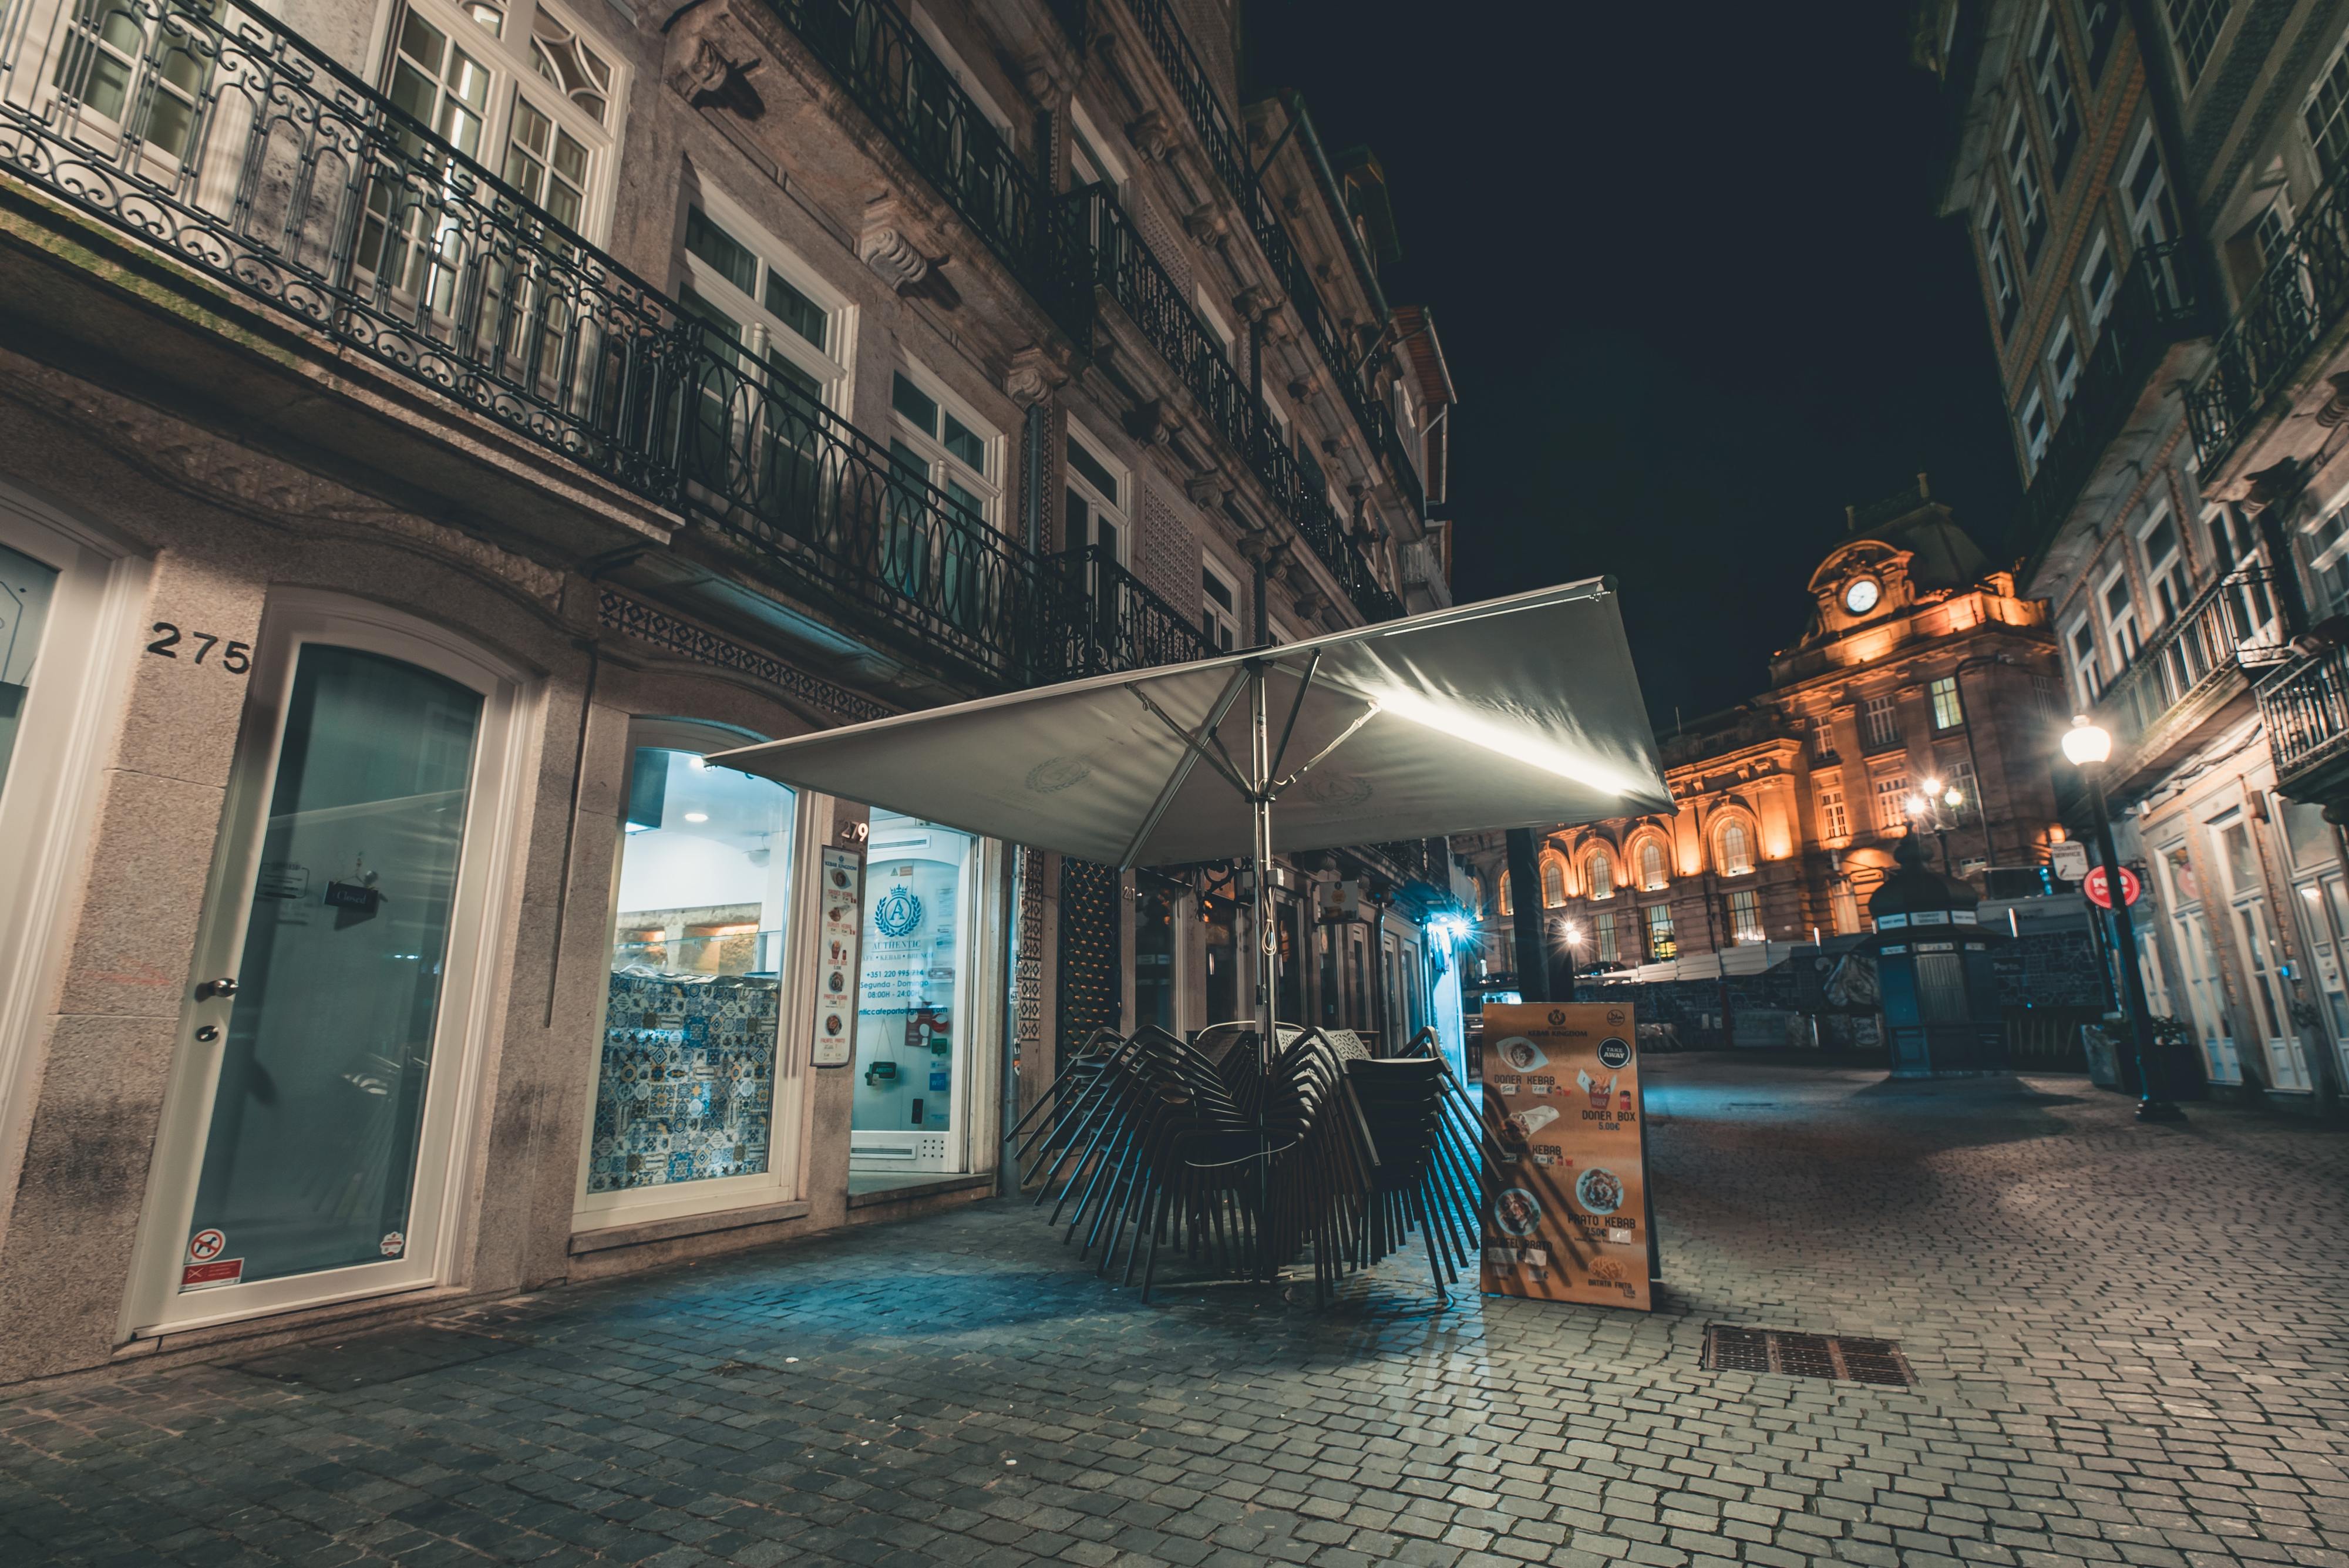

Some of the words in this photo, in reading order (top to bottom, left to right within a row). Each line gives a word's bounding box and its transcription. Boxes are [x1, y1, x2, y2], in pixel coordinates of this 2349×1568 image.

[147, 622, 251, 674] 275
[842, 821, 869, 842] 279
[336, 890, 367, 904] Closed
[1123, 886, 1135, 901] 281
[873, 940, 921, 950] AUTHENTIC
[860, 981, 890, 990] Segunda
[1494, 1074, 1522, 1084] DONER
[1527, 1075, 1555, 1085] KEBAB
[1581, 1110, 1612, 1121] DONER
[1617, 1111, 1636, 1122] BOX
[1532, 1145, 1561, 1156] KEBAB
[1567, 1213, 1599, 1226] PRATO
[1604, 1216, 1636, 1229] KEBAB
[1587, 1278, 1612, 1287] BATATA
